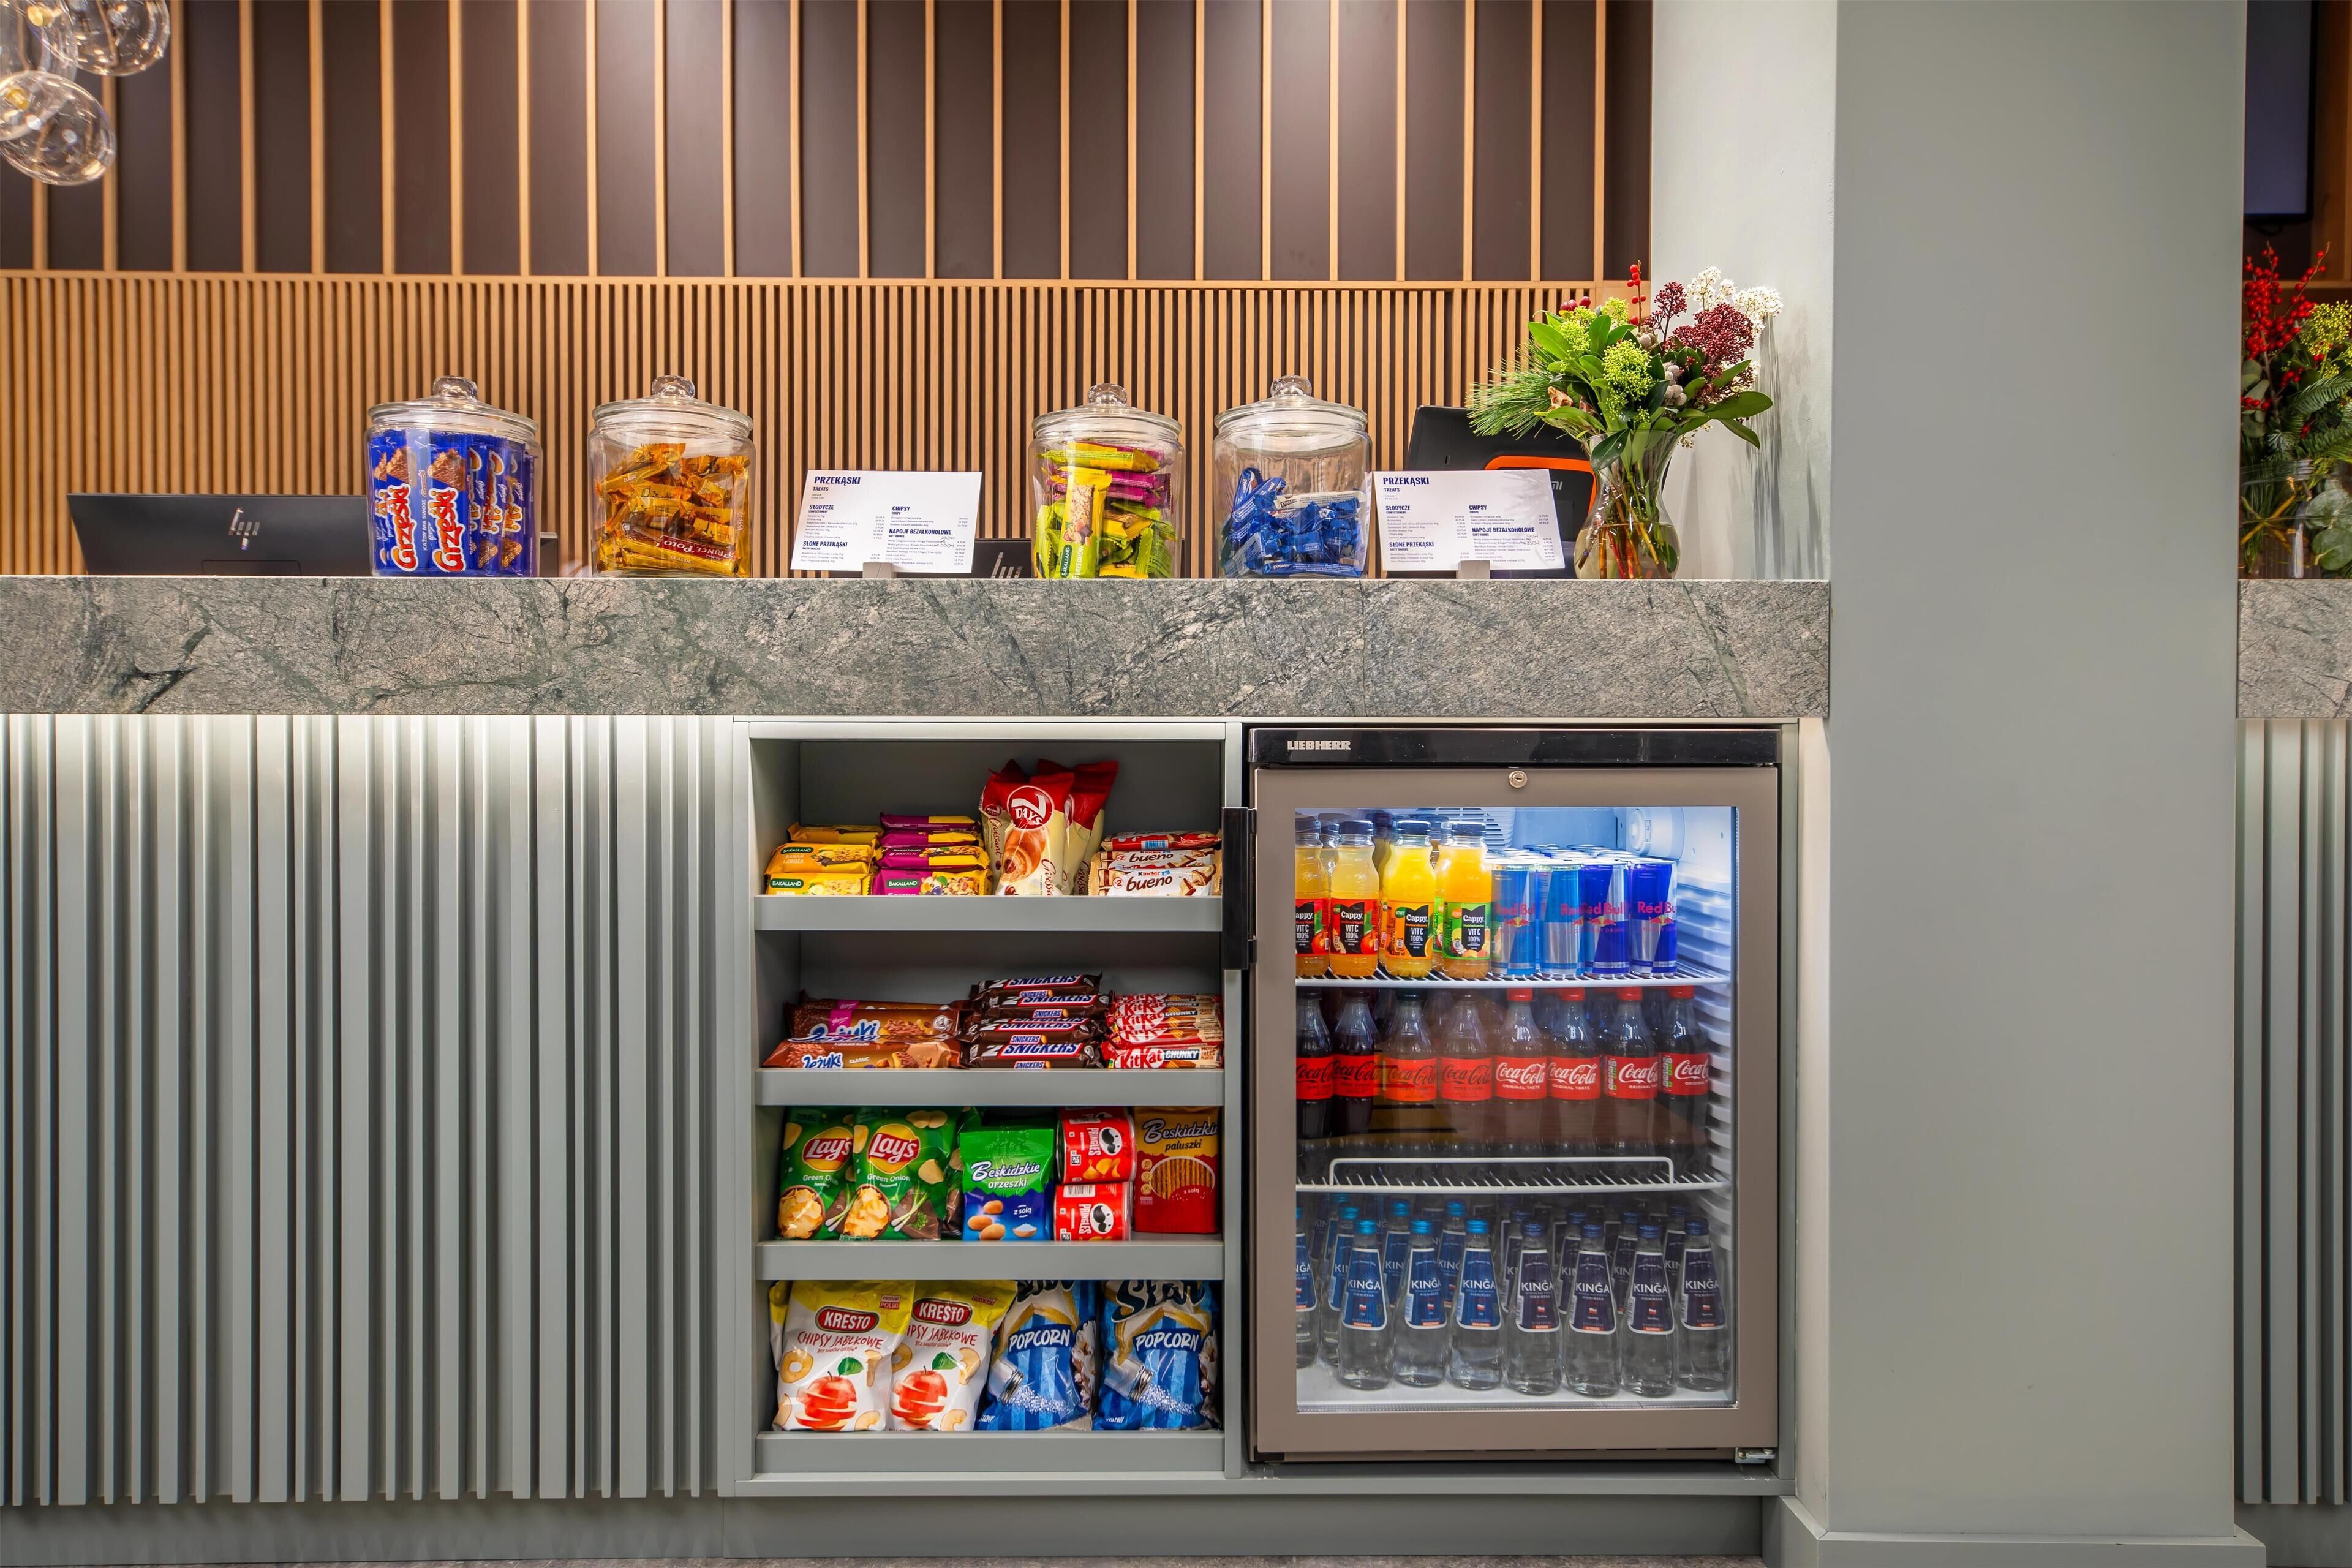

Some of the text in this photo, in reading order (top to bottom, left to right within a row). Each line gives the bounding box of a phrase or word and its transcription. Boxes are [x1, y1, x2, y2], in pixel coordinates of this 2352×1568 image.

[814, 477, 861, 486] PRZEKĄSKI
[1383, 477, 1429, 486] PRZEKĄSKI
[428, 487, 466, 572] Grześki
[664, 540, 695, 553] POLO
[1061, 547, 1070, 576] BAKALLAND
[1287, 740, 1351, 750] LIEBHERR
[1011, 794, 1046, 819] 7
[1015, 807, 1042, 827] DAYS
[1129, 853, 1173, 863] bueno
[1126, 876, 1173, 892] bueno
[1638, 901, 1662, 914] Red
[981, 1043, 1077, 1057] 2 SNICKERS
[1120, 1048, 1163, 1069] KitKat
[1165, 1050, 1199, 1060] CHUNKY
[1495, 1062, 1546, 1085] Coca-Cola
[1547, 1062, 1597, 1085] Coca-Cola
[805, 1137, 853, 1161] Lay's
[870, 1134, 917, 1164] Lay's
[1087, 1128, 1101, 1156] PRINGLES
[1165, 1139, 1202, 1153] paluszki
[867, 1173, 911, 1183] Green Onion
[971, 1161, 1041, 1182] Beskidzkie
[988, 1177, 1027, 1189] orzeszki
[1079, 1204, 1092, 1234] PRINGLES
[824, 1311, 871, 1330] KRESTO
[919, 1303, 964, 1322] KRESTO
[797, 1331, 883, 1349] CHIPSY JABŁKOWE
[928, 1328, 978, 1347] JABŁKOWE
[1009, 1328, 1071, 1352] POPCORN
[1136, 1332, 1199, 1352] POPCORN
